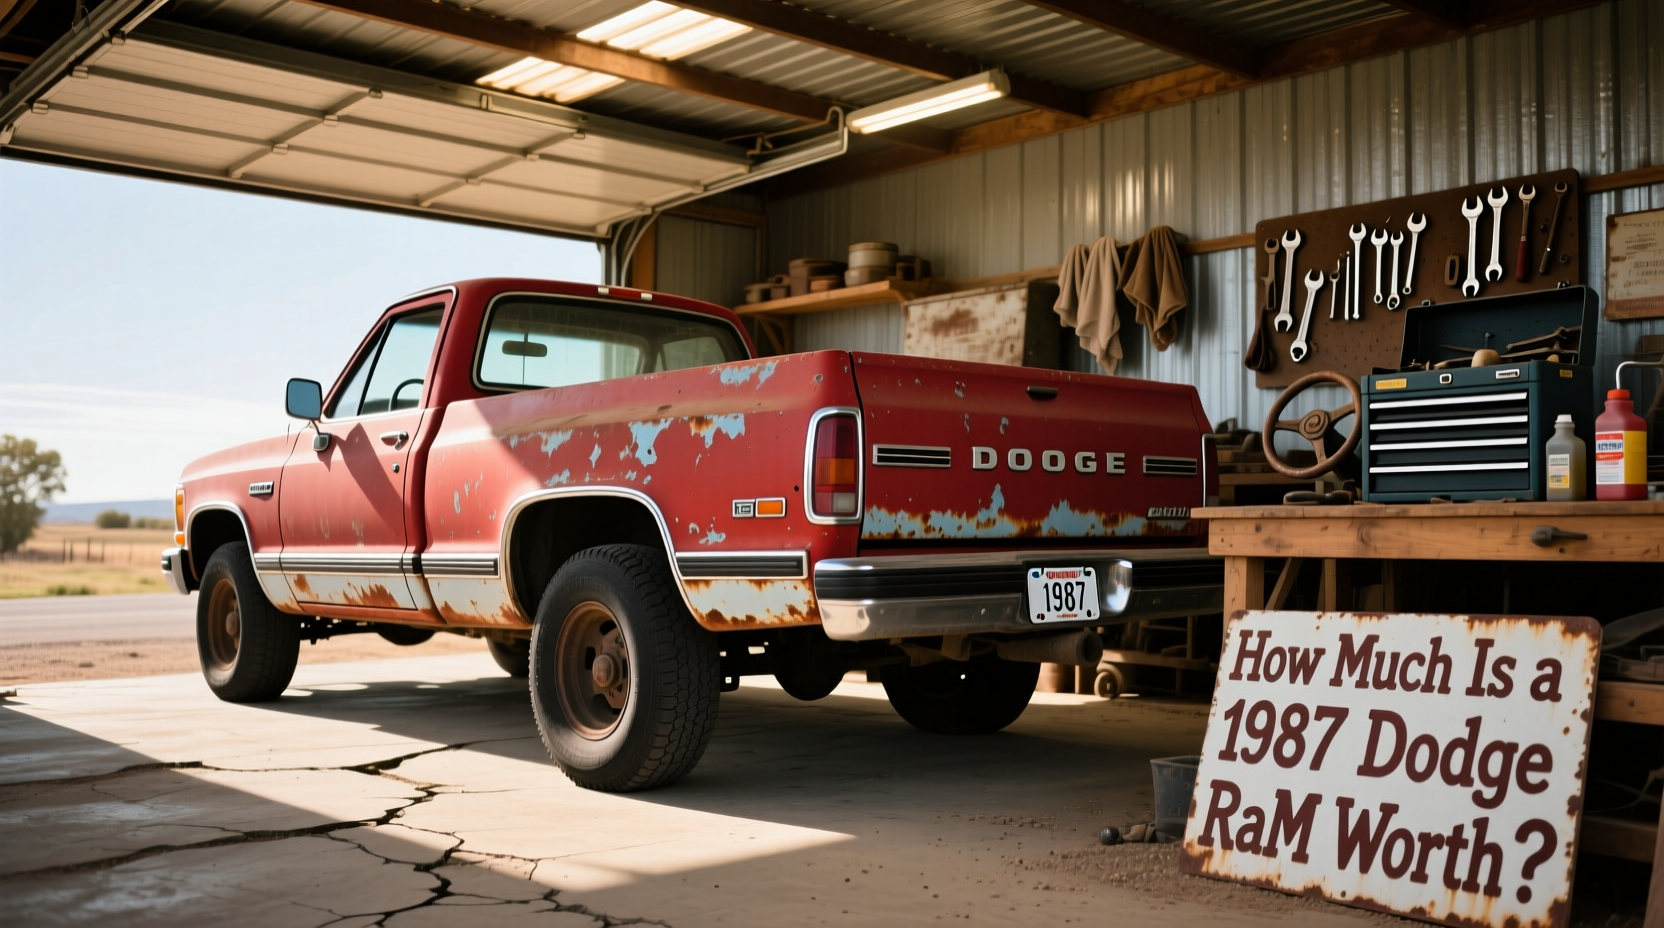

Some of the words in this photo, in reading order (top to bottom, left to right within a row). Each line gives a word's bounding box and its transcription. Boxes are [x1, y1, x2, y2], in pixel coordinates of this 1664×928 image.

[1043, 581, 1085, 612] 1987
[1229, 629, 1326, 685] How
[1329, 633, 1453, 695] Much
[1465, 638, 1517, 699] Is
[1530, 658, 1563, 702] a
[1218, 699, 1350, 771] 1987
[1357, 709, 1554, 809] Dodge
[1198, 779, 1323, 864] RaM
[1336, 797, 1558, 904] Worth?
